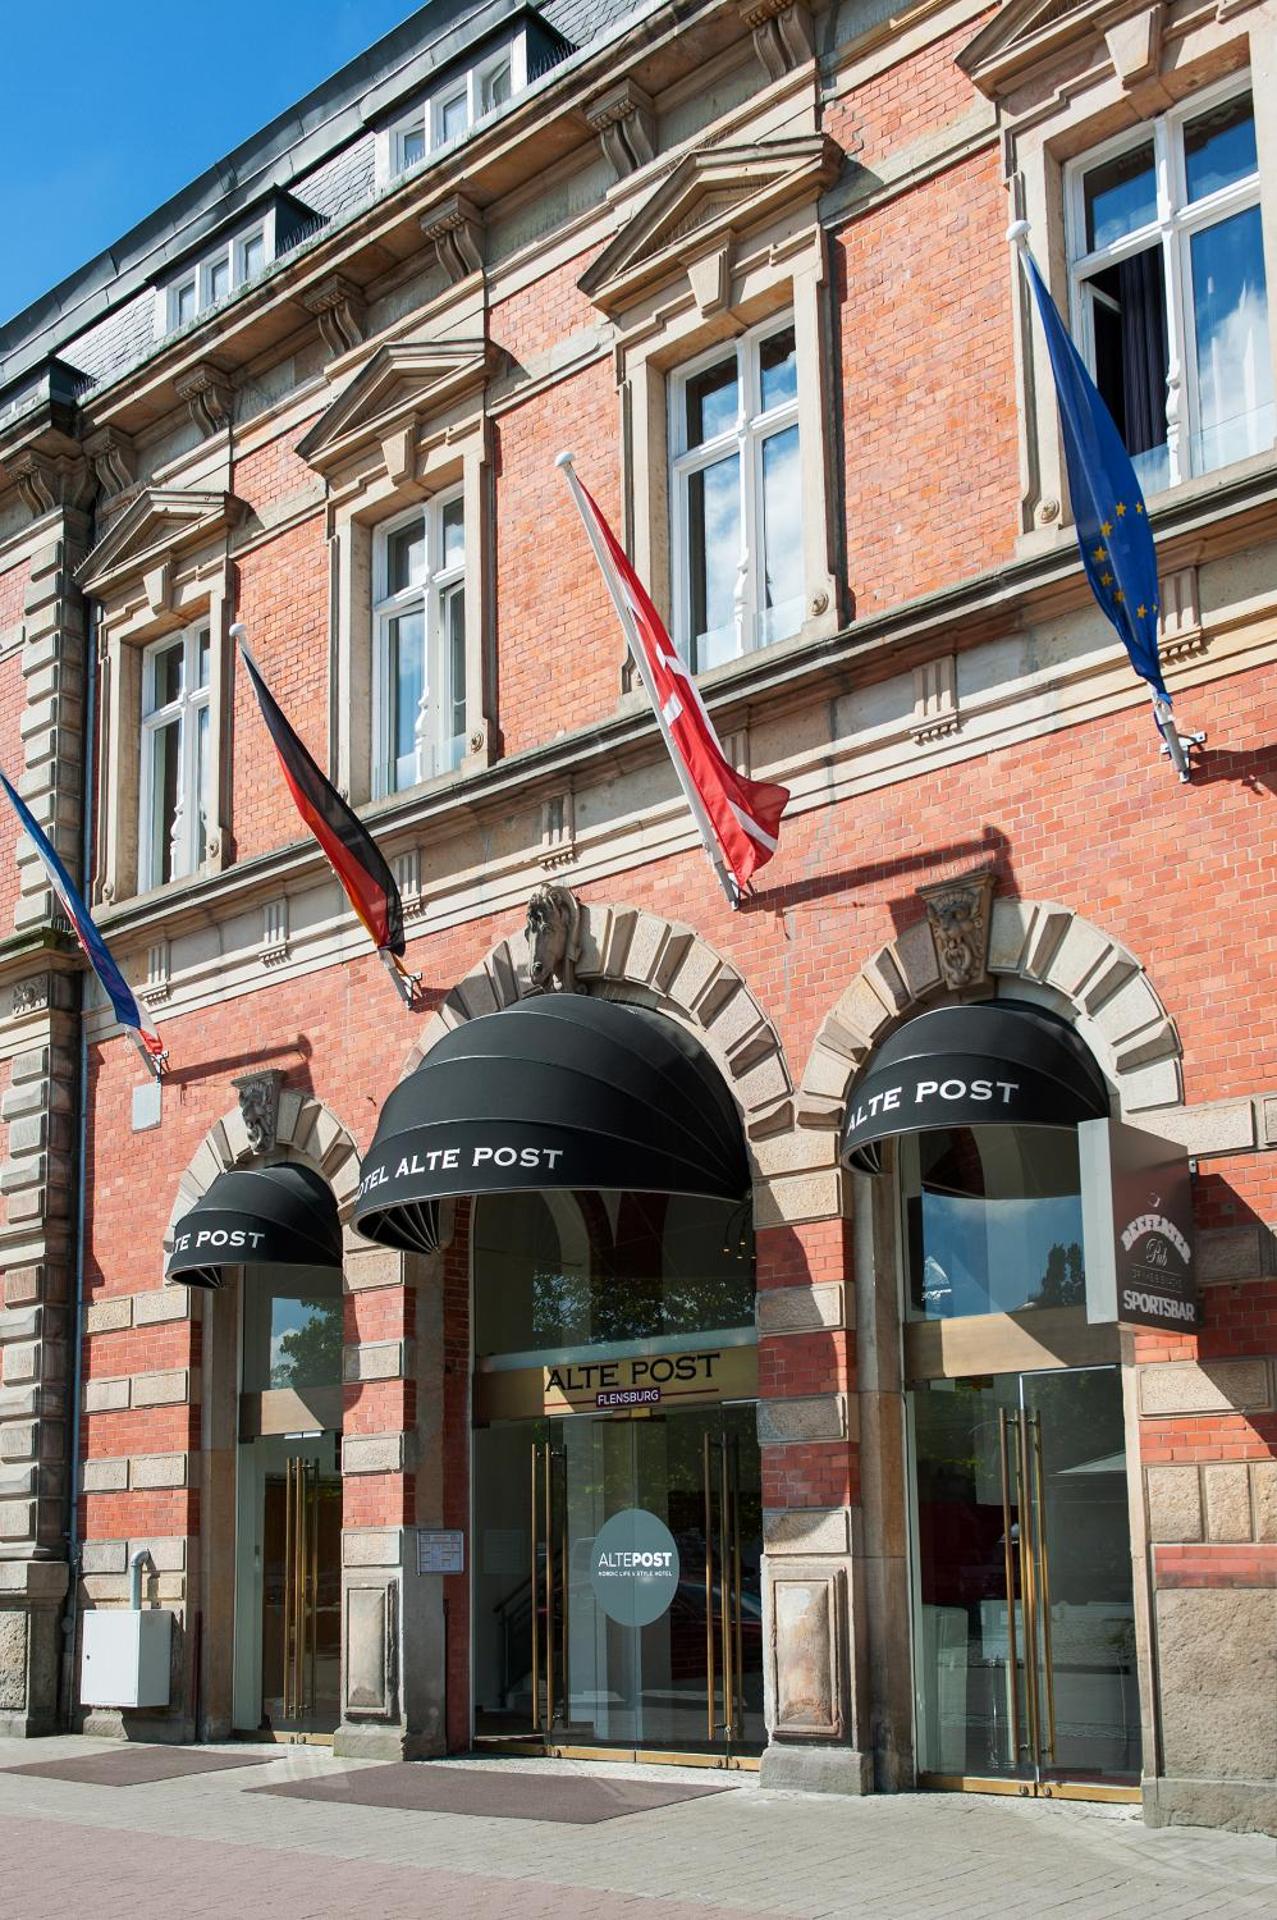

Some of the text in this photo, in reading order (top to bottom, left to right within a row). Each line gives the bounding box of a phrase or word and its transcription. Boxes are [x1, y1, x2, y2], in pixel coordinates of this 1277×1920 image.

[847, 1079, 1019, 1137] ALTE POST
[395, 1148, 460, 1178] ALTE
[472, 1147, 563, 1169] POST
[174, 1230, 265, 1253] TE POST
[1123, 1289, 1195, 1321] SPORTSBAR
[545, 1352, 720, 1391] ALTE POST
[597, 1389, 659, 1405] FLENSBURG
[598, 1552, 672, 1567] ALTEPOST
